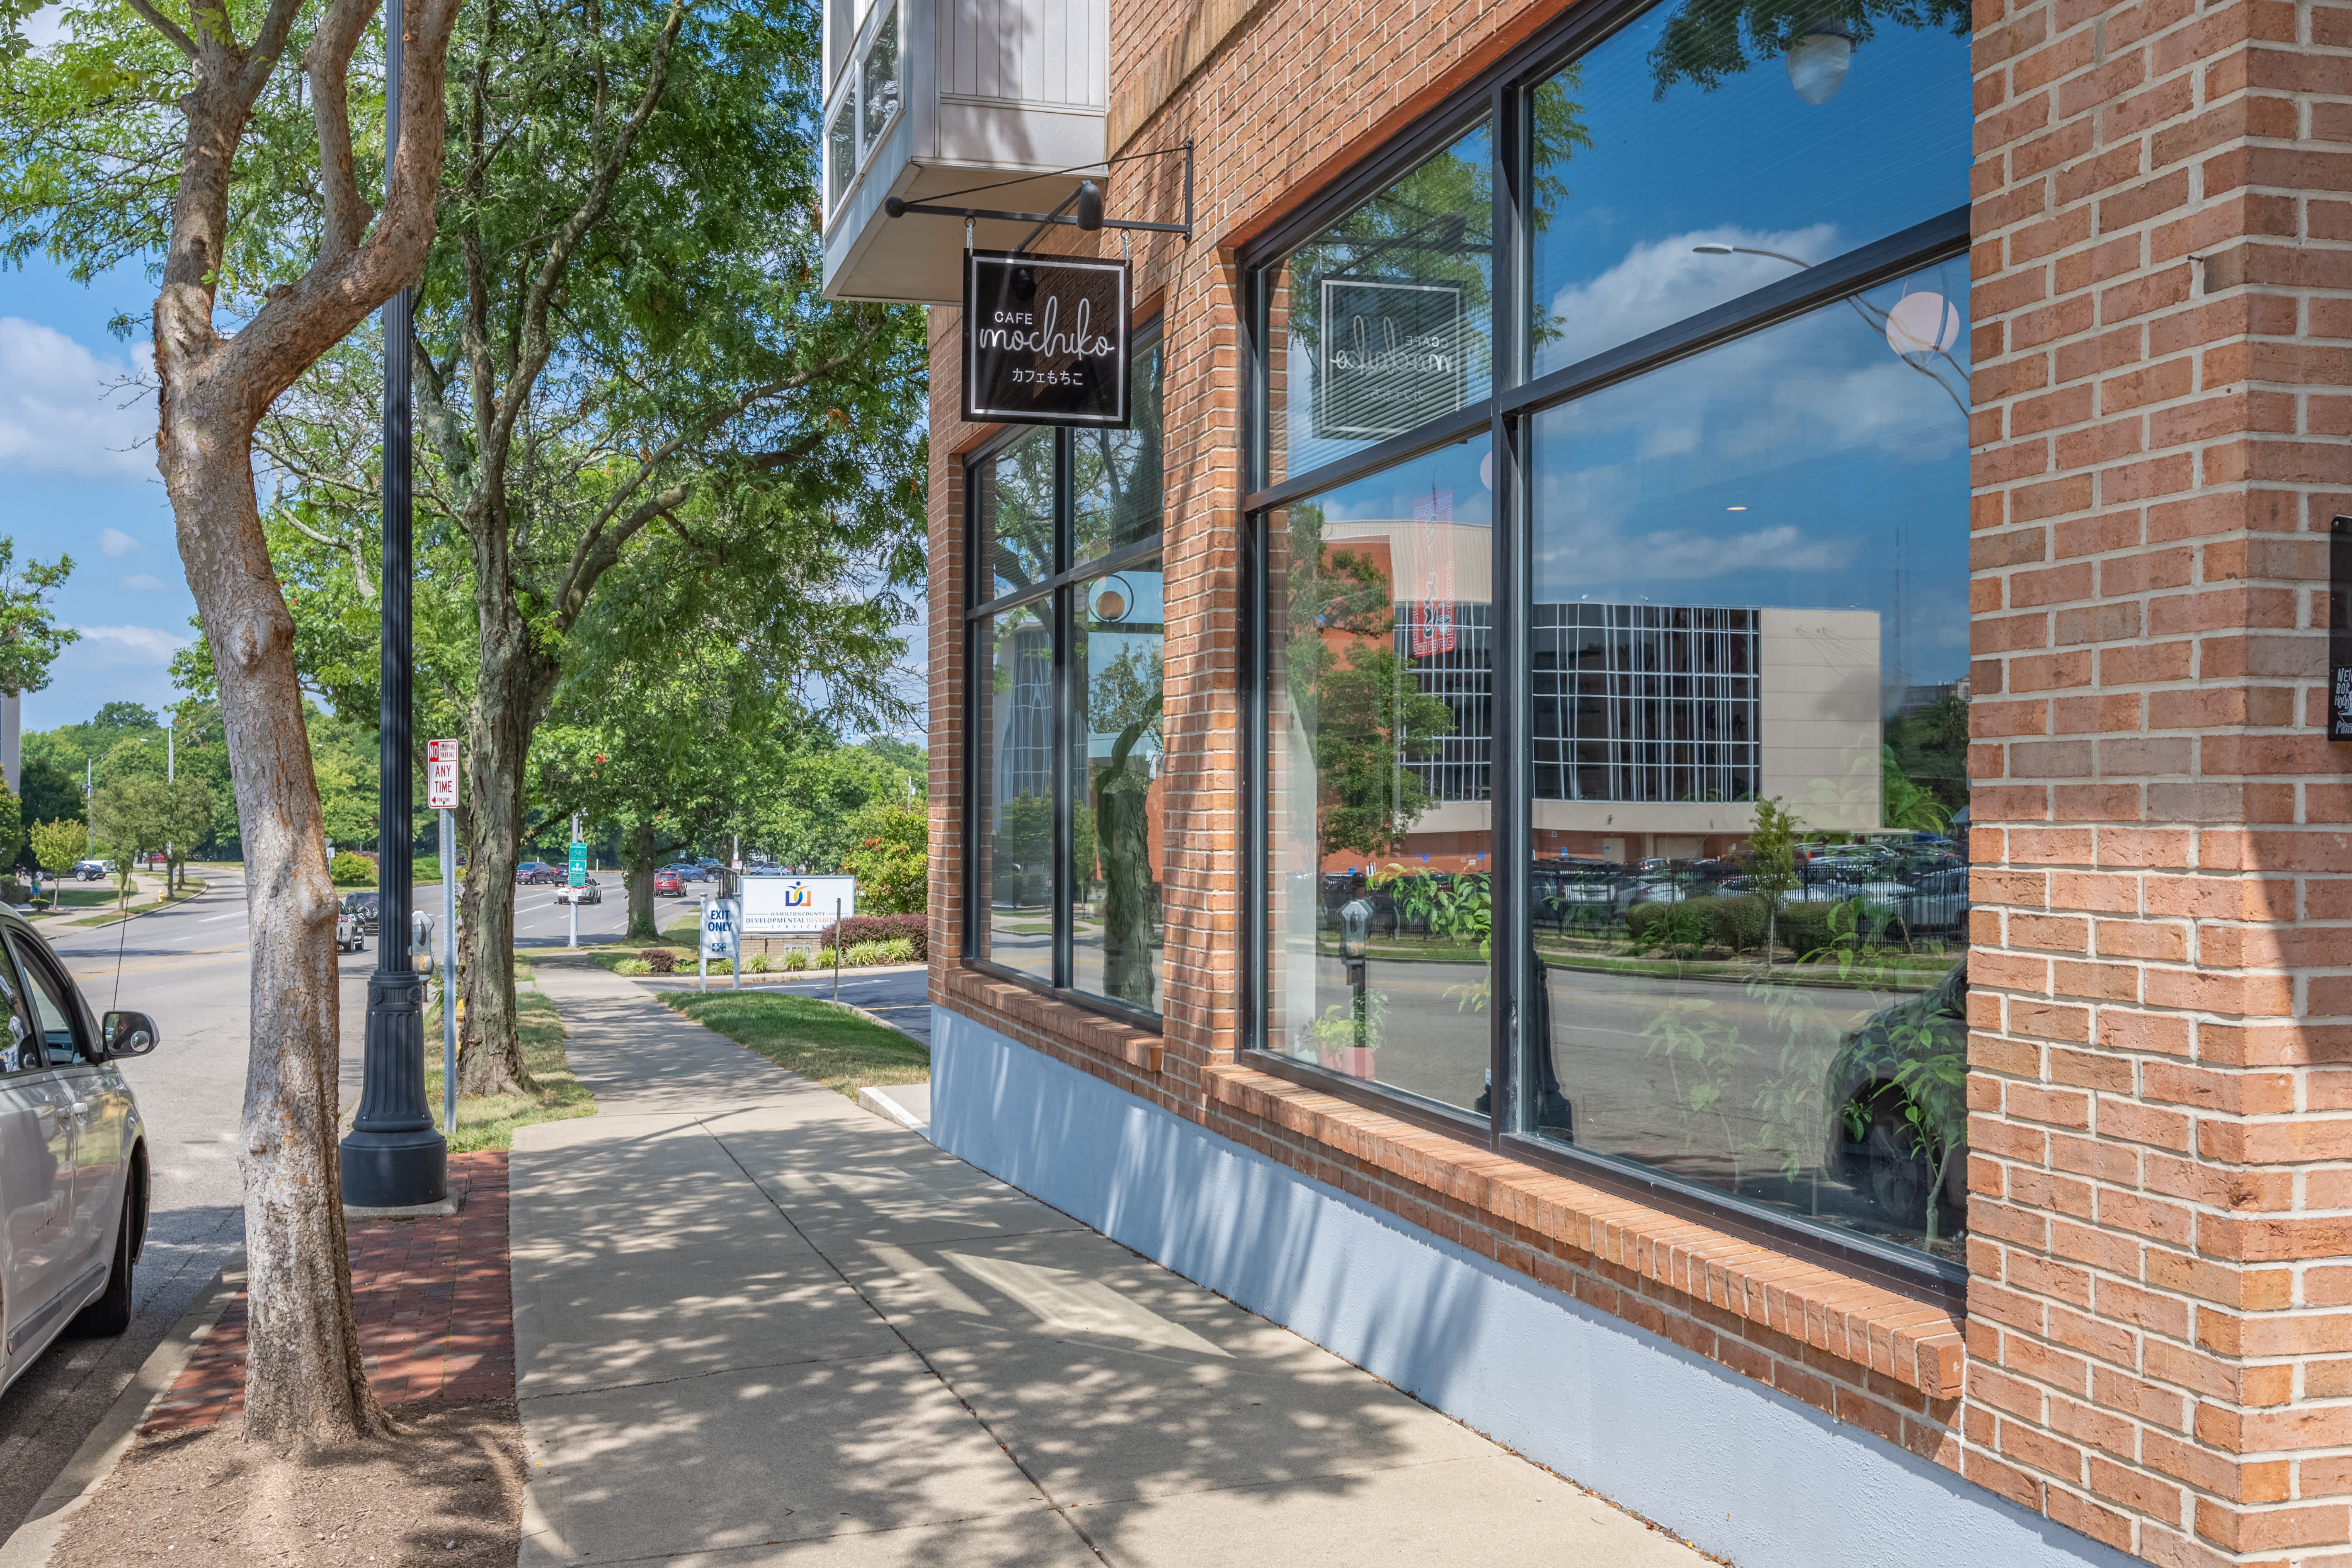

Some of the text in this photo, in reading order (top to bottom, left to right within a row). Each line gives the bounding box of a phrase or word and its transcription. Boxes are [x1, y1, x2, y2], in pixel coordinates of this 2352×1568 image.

[994, 311, 1033, 325] CAFE
[1012, 368, 1083, 385] カフェもちこ
[2337, 667, 2352, 682] NEI
[2336, 682, 2350, 694] BOR
[2335, 694, 2350, 709] HOOD
[429, 744, 438, 758] NO
[435, 765, 451, 777] ANY
[434, 780, 452, 793] TIME
[711, 910, 730, 920] EXIT
[708, 922, 732, 931] ONLY
